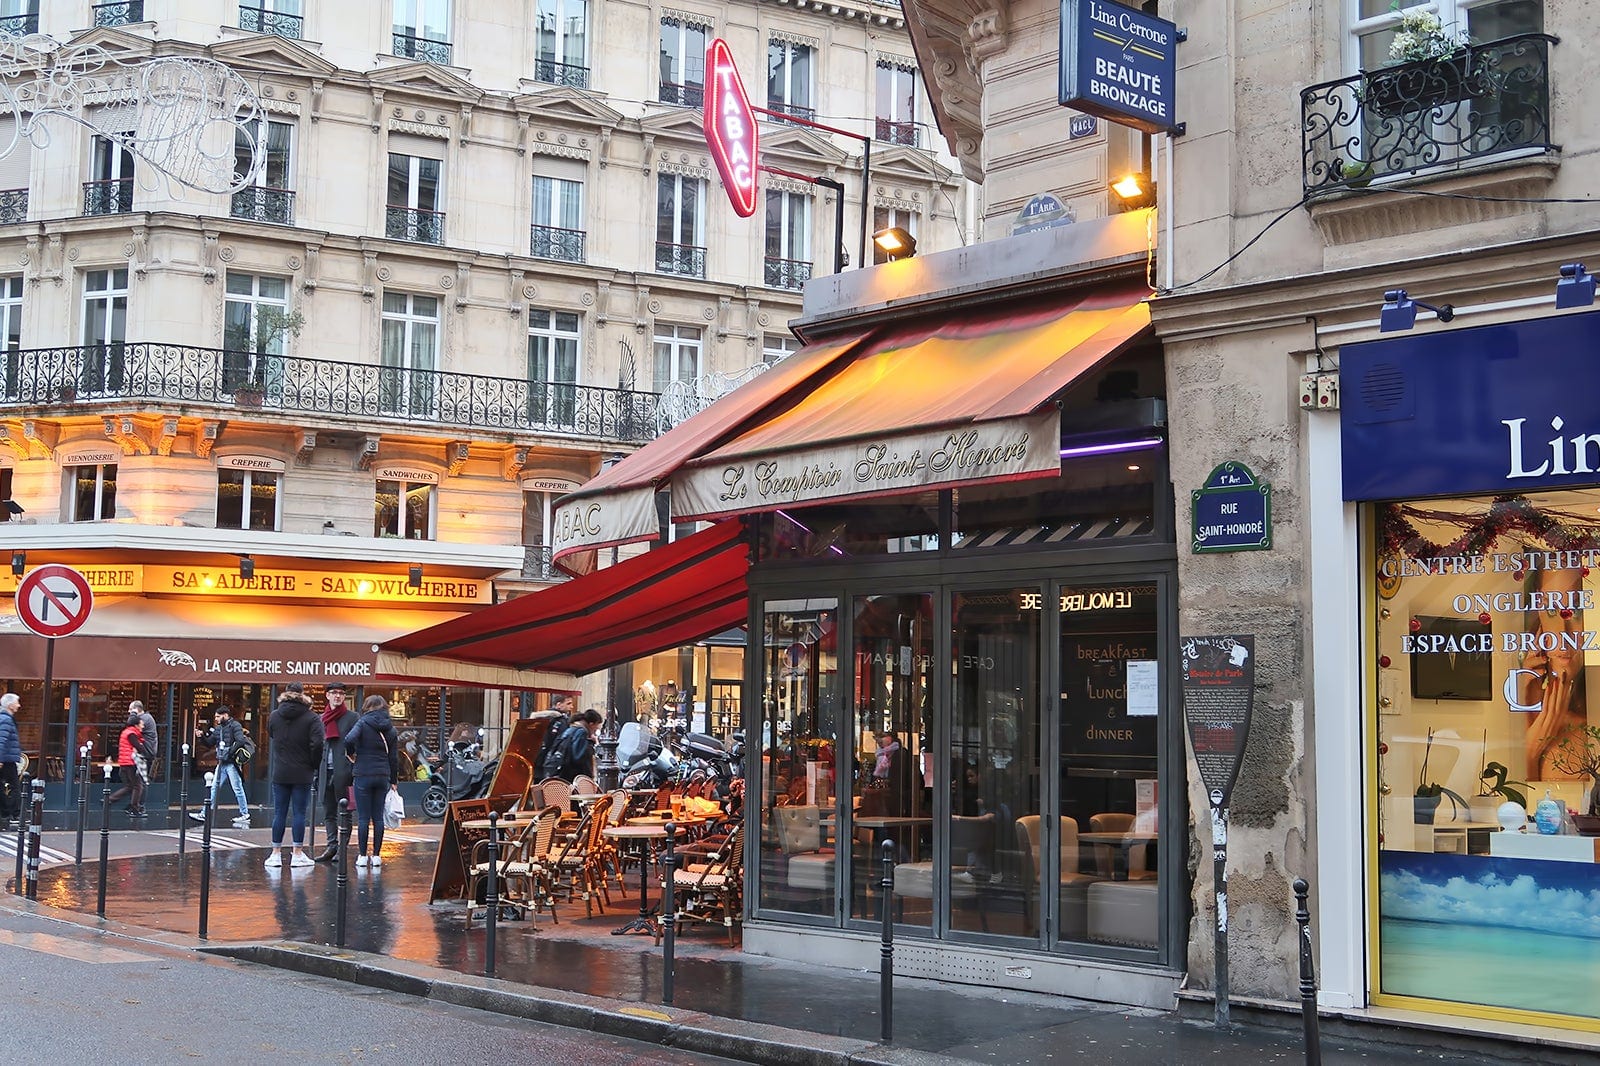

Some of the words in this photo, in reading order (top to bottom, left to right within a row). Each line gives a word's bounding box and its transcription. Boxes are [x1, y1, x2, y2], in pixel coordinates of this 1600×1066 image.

[1089, 1, 1117, 28] Lina
[1119, 13, 1167, 45] Cerrone
[1095, 57, 1161, 96] BEAUTÉ
[1090, 79, 1166, 117] BRONZAGE
[717, 66, 752, 188] TABAC
[67, 453, 115, 462] VIENNOISERIE
[231, 458, 271, 468] CREPERIE
[718, 464, 748, 501] Le
[753, 460, 842, 502] Comptoir
[853, 429, 1030, 483] Saint-Honoré
[382, 469, 433, 480] SANDWICHES
[534, 481, 569, 490] CREPERIE
[1220, 503, 1238, 515] RUE
[1199, 520, 1263, 538] SAINT-HONORÉ
[1381, 554, 1486, 578] CENTRE
[172, 571, 296, 591] SAADERIE
[321, 577, 478, 599] SANDWICHERIE
[1452, 589, 1595, 614] ONGLERIE
[1401, 632, 1494, 655] ESPACE
[1502, 630, 1600, 653] BRONZ
[205, 658, 220, 673] LA
[225, 659, 282, 674] CREPERIE
[286, 660, 320, 676] SAINT
[324, 661, 371, 677] HONORE
